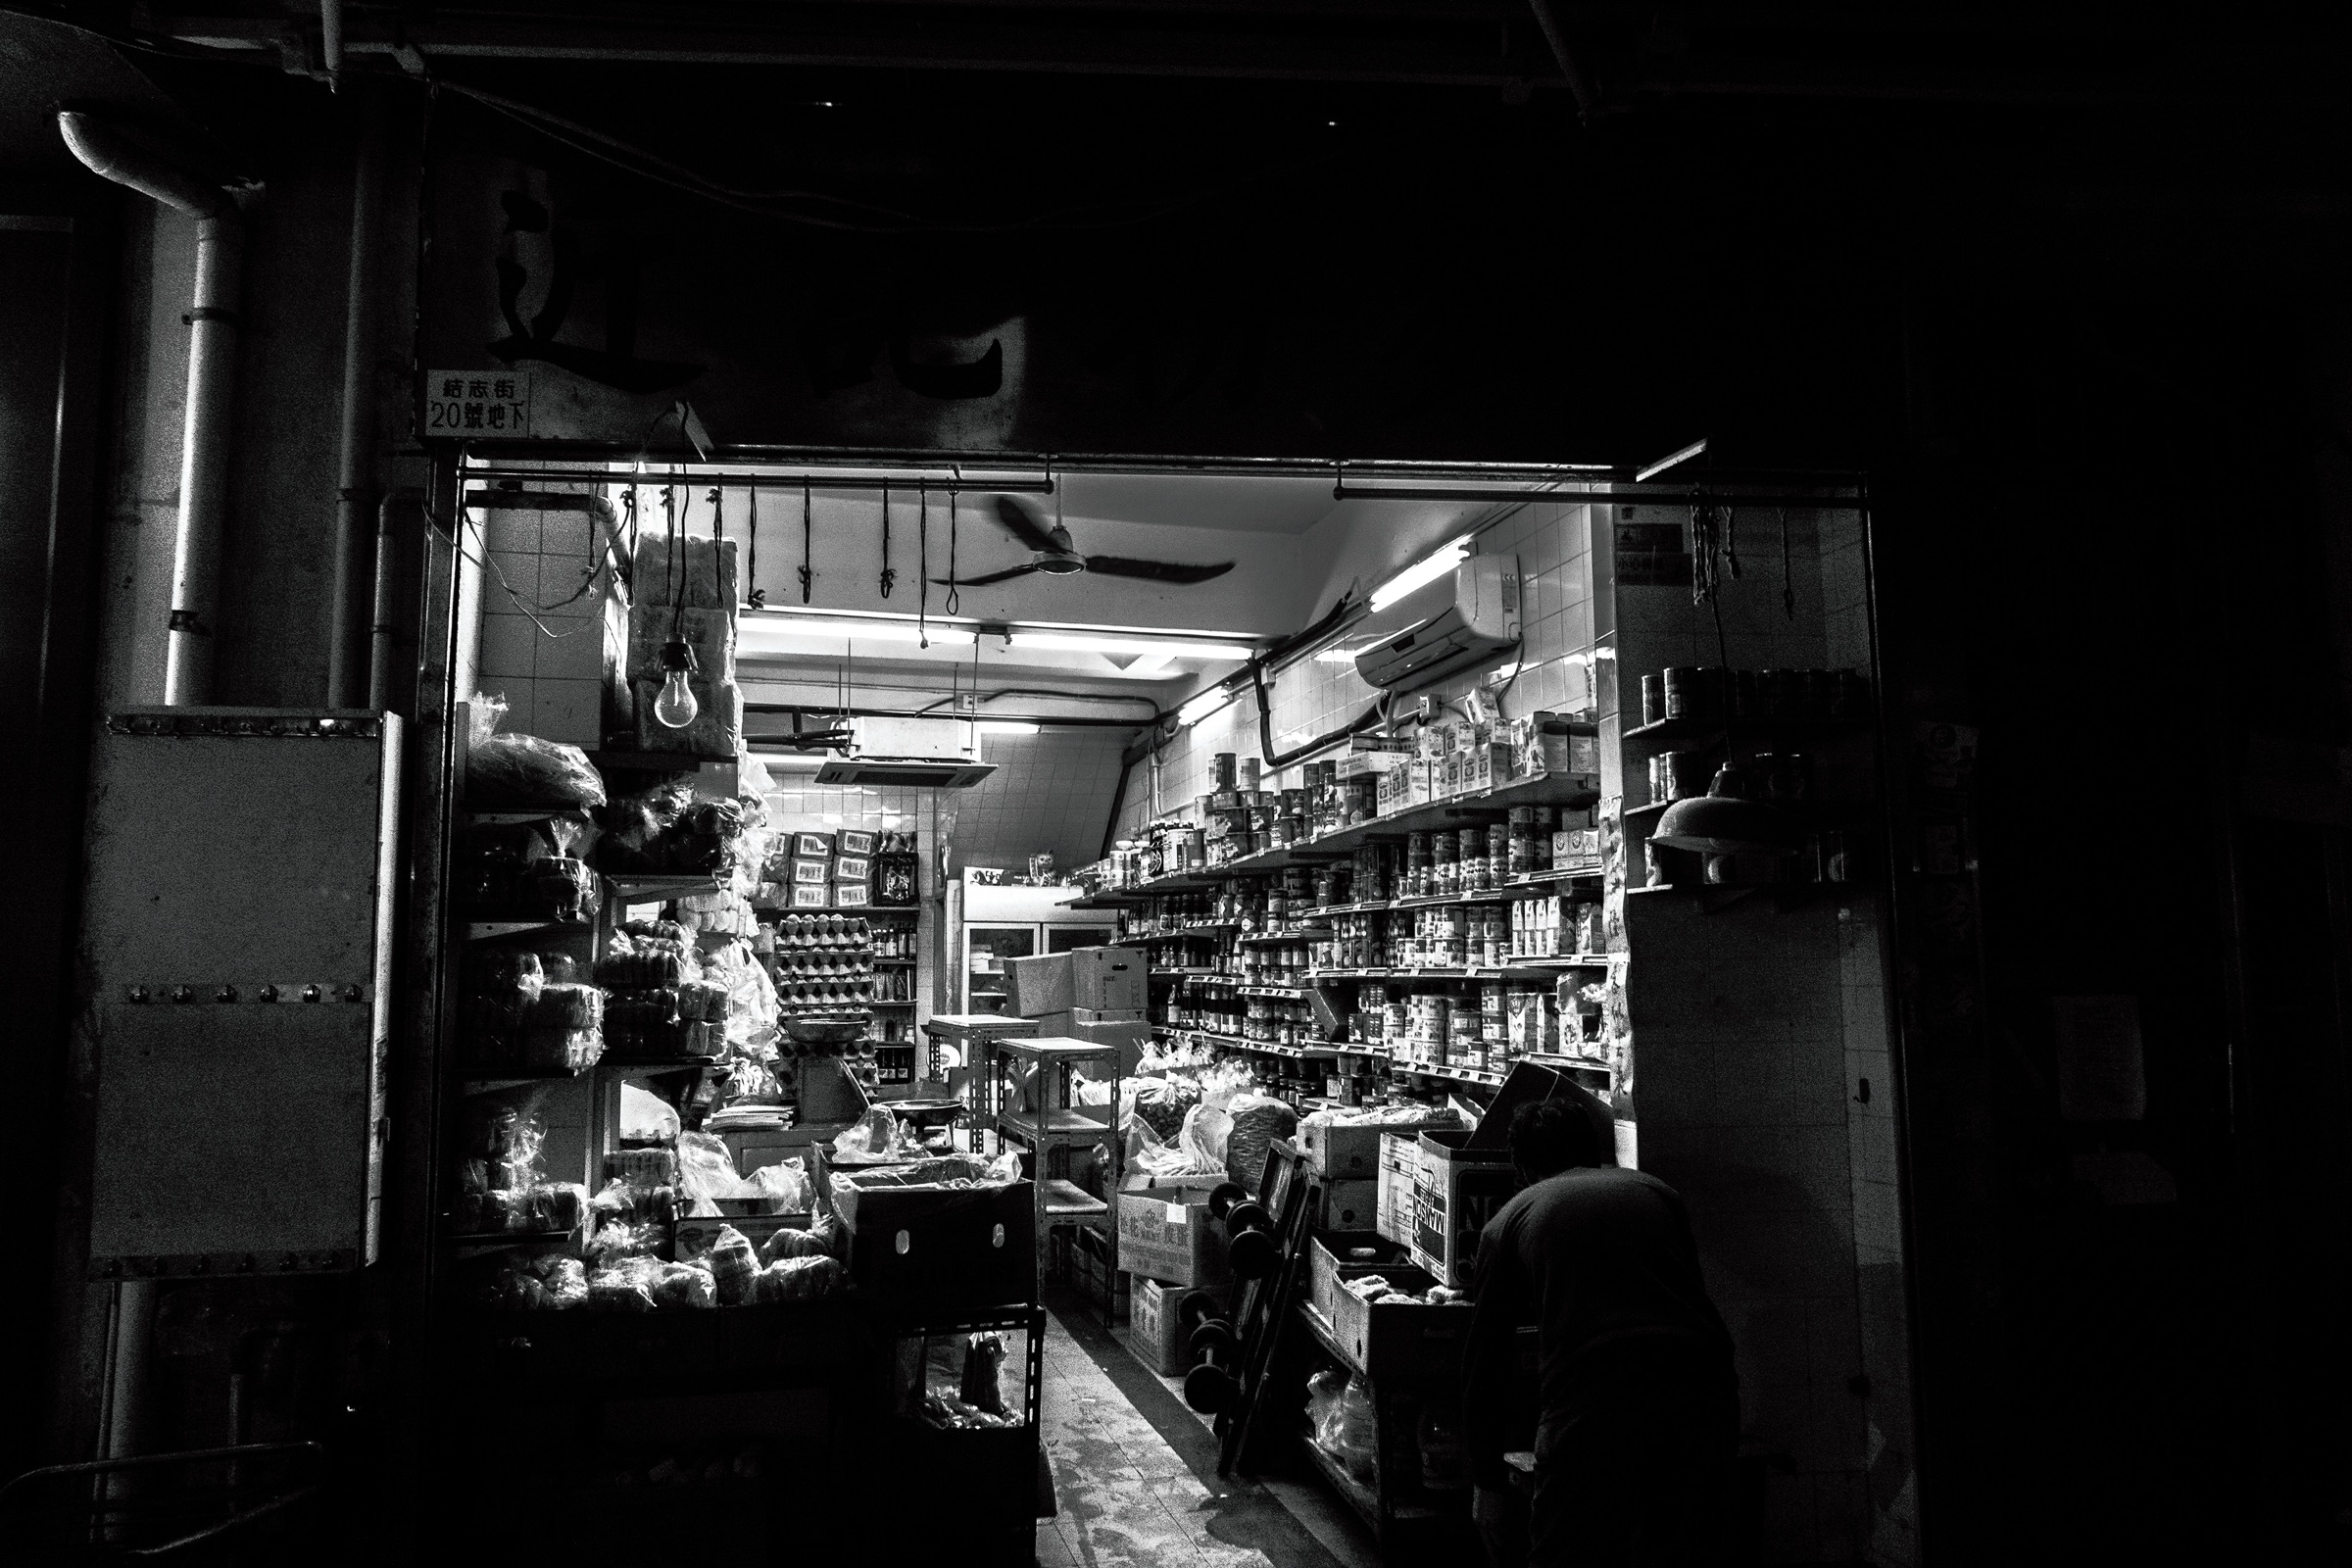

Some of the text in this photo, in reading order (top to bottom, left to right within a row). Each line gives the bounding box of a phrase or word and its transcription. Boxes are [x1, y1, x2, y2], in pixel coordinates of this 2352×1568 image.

[443, 379, 515, 399] 結志街
[431, 401, 524, 429] 20號地下
[1413, 1195, 1445, 1235] MANSON
